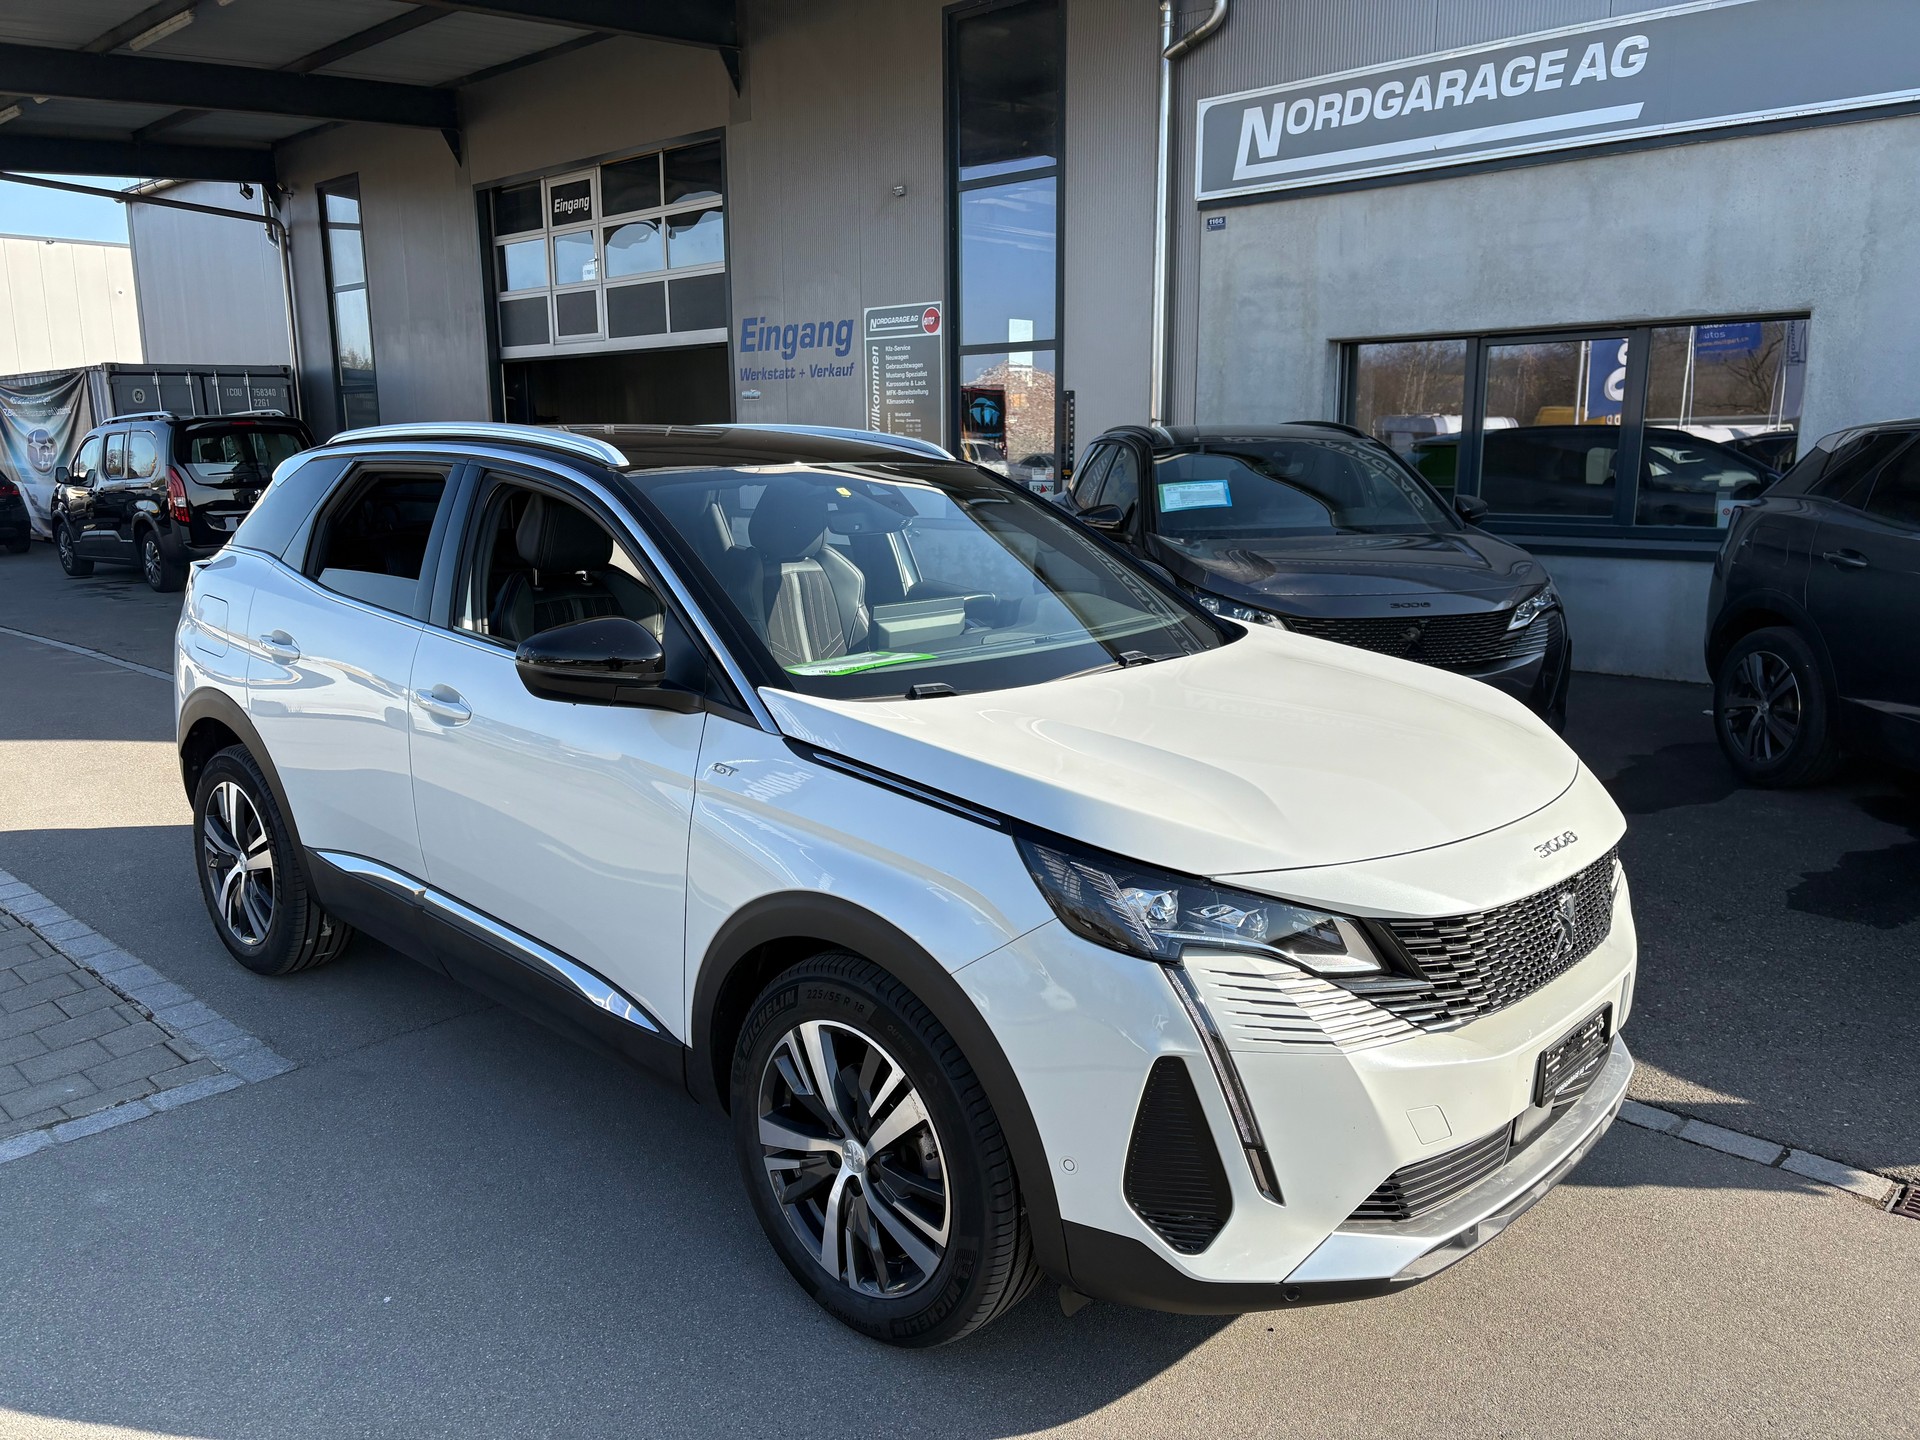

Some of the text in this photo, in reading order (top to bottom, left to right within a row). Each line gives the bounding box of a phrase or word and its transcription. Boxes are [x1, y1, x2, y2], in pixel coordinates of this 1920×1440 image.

[1233, 34, 1650, 178] NORDGARAGE AG
[554, 196, 590, 214] Eingang
[869, 314, 919, 331] NORDGARAGE AG
[740, 316, 854, 360] Eingang
[740, 362, 855, 381] Werkstatt + Verkauf
[252, 388, 277, 397] 758340
[253, 399, 270, 407] 22G1
[712, 762, 739, 776] GT
[1533, 830, 1578, 858] 3008
[742, 989, 866, 1053] MICHELIN 225/55 R 18
